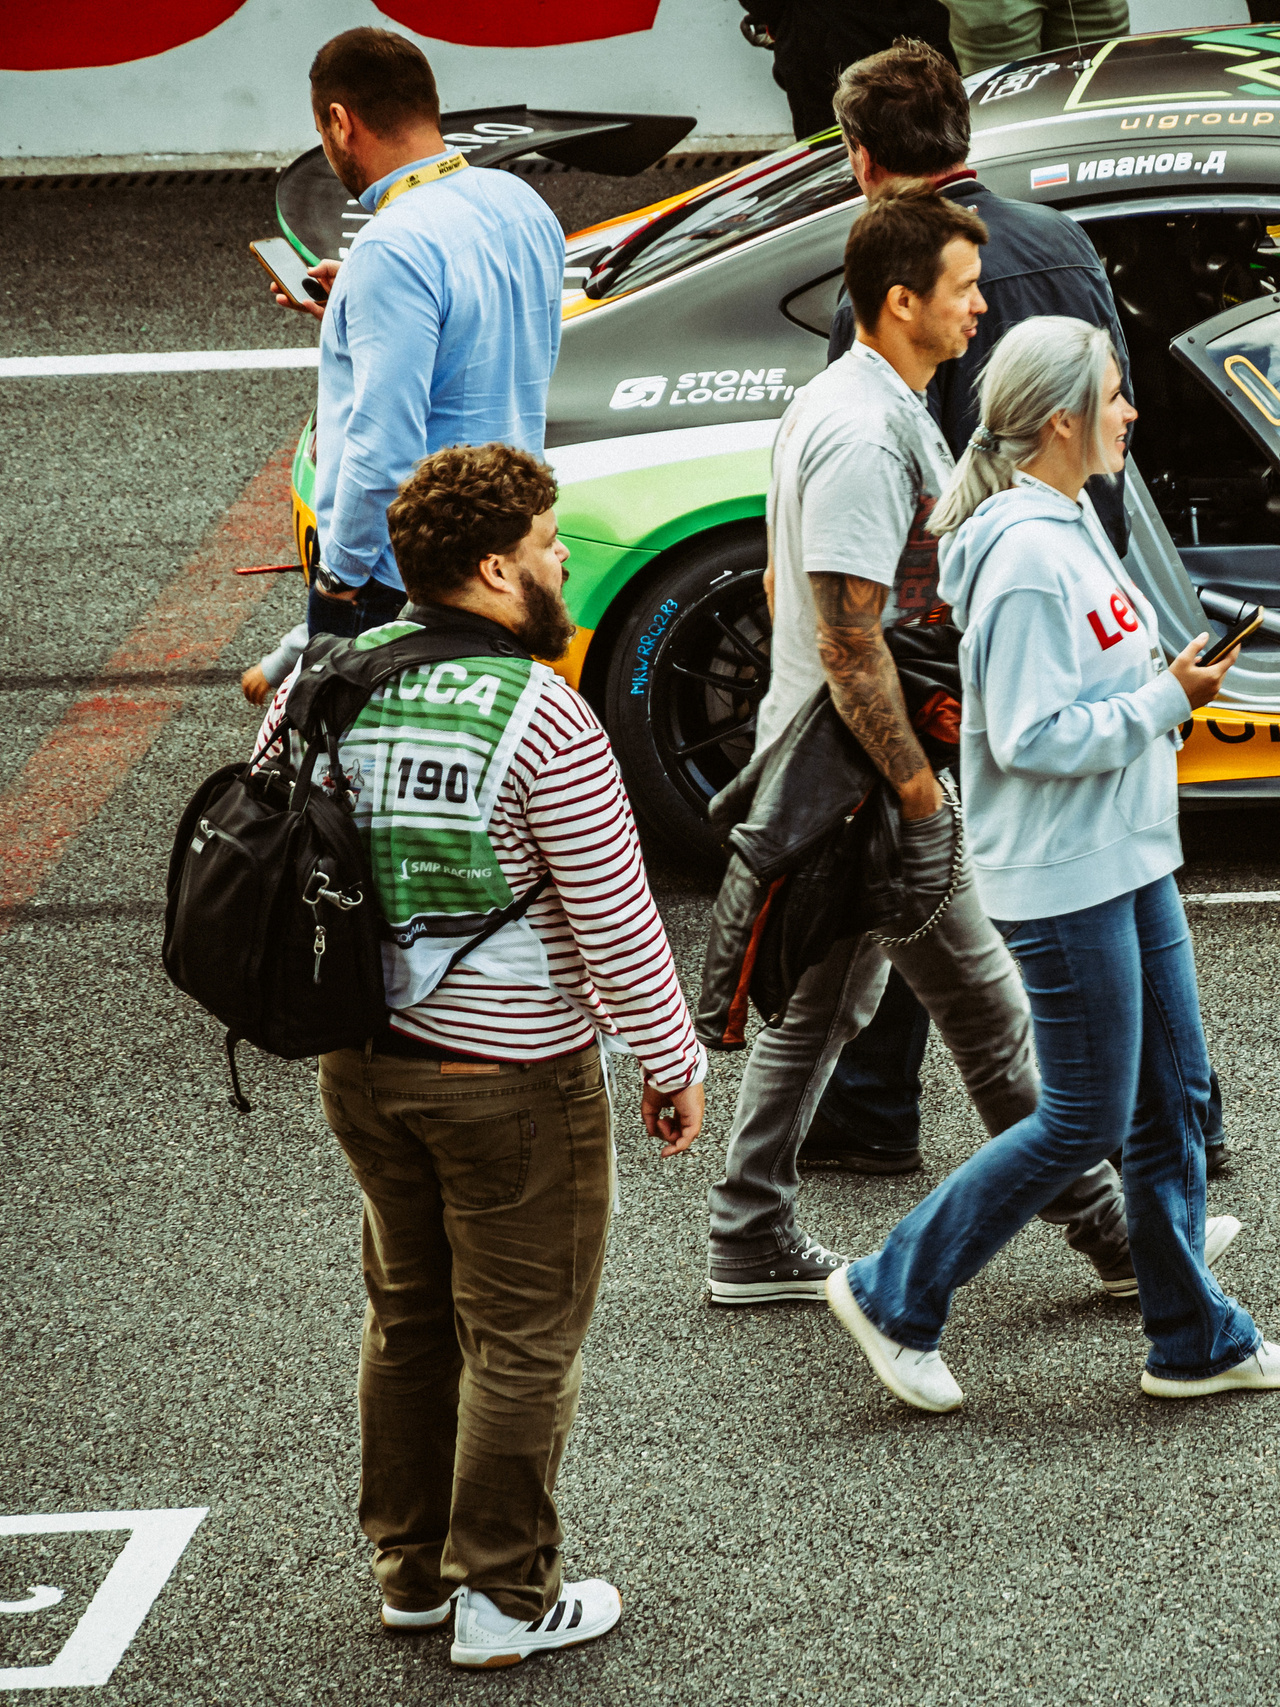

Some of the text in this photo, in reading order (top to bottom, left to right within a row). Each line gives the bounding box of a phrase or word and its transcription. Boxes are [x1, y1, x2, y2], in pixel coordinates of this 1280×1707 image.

[676, 368, 786, 389] STONE
[397, 757, 469, 804] 190
[411, 861, 492, 879] SMP RACING
